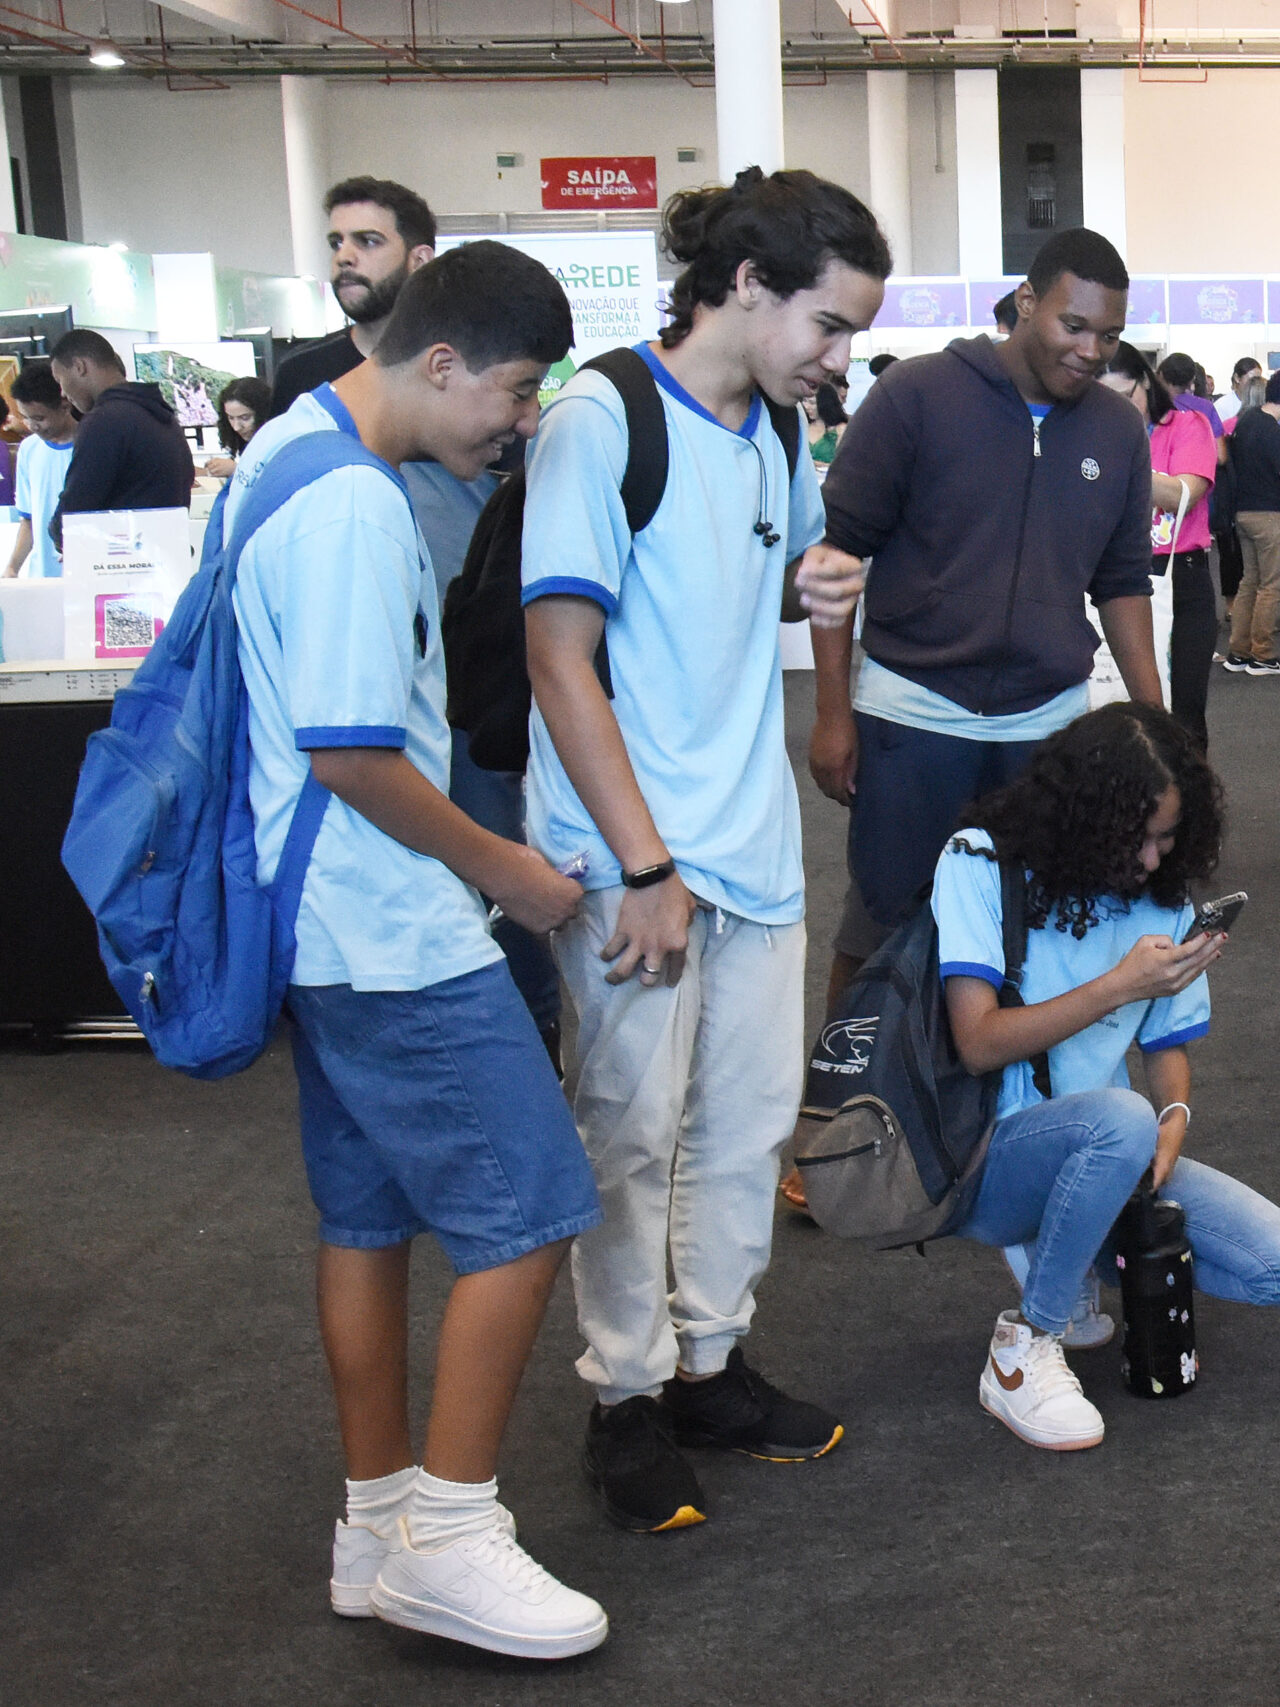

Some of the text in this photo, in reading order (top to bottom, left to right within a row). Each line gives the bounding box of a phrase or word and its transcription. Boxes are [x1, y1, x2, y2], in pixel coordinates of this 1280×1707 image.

[567, 167, 630, 185] SAÍDA
[561, 184, 638, 196] DE EMERGÊNCIA
[569, 296, 640, 311] NOVAÇÃO QUE
[575, 311, 641, 325] ANSFORMA A
